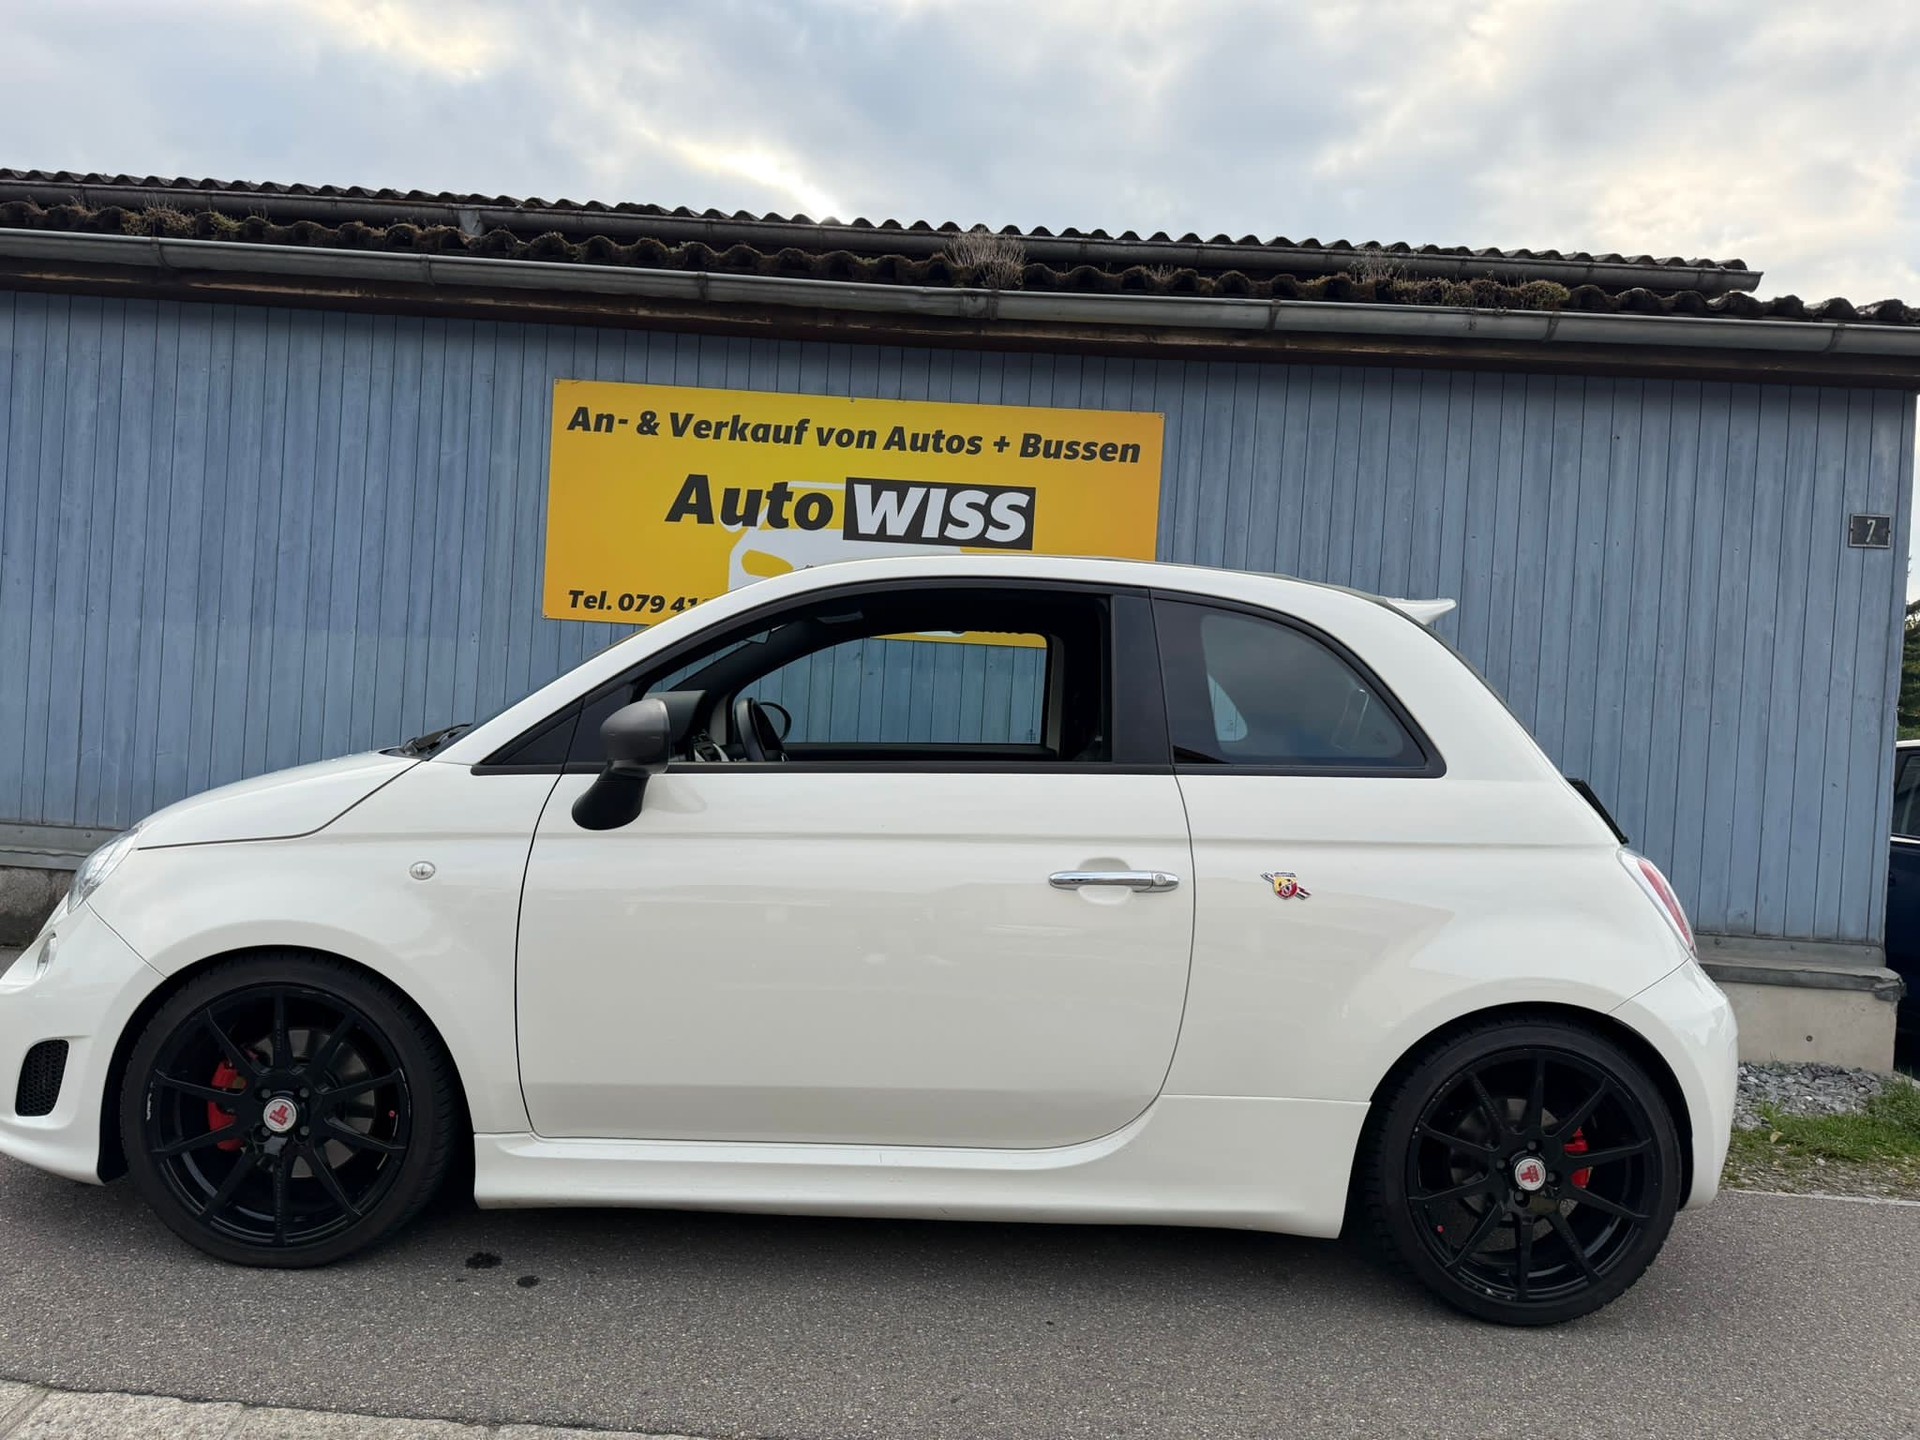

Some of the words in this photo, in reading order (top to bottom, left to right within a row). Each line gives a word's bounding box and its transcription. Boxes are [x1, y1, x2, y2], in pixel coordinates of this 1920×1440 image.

[566, 406, 629, 433] An-
[636, 410, 661, 436] &
[669, 412, 811, 445] Verkauf
[816, 426, 877, 449] von
[882, 425, 983, 455] Autos
[993, 435, 1011, 453] +
[1019, 432, 1141, 464] Bussen
[664, 473, 835, 532] Auto
[853, 483, 1031, 543] WISS
[1866, 519, 1876, 543] 7
[568, 589, 612, 610] Tel.
[618, 593, 666, 613] 079
